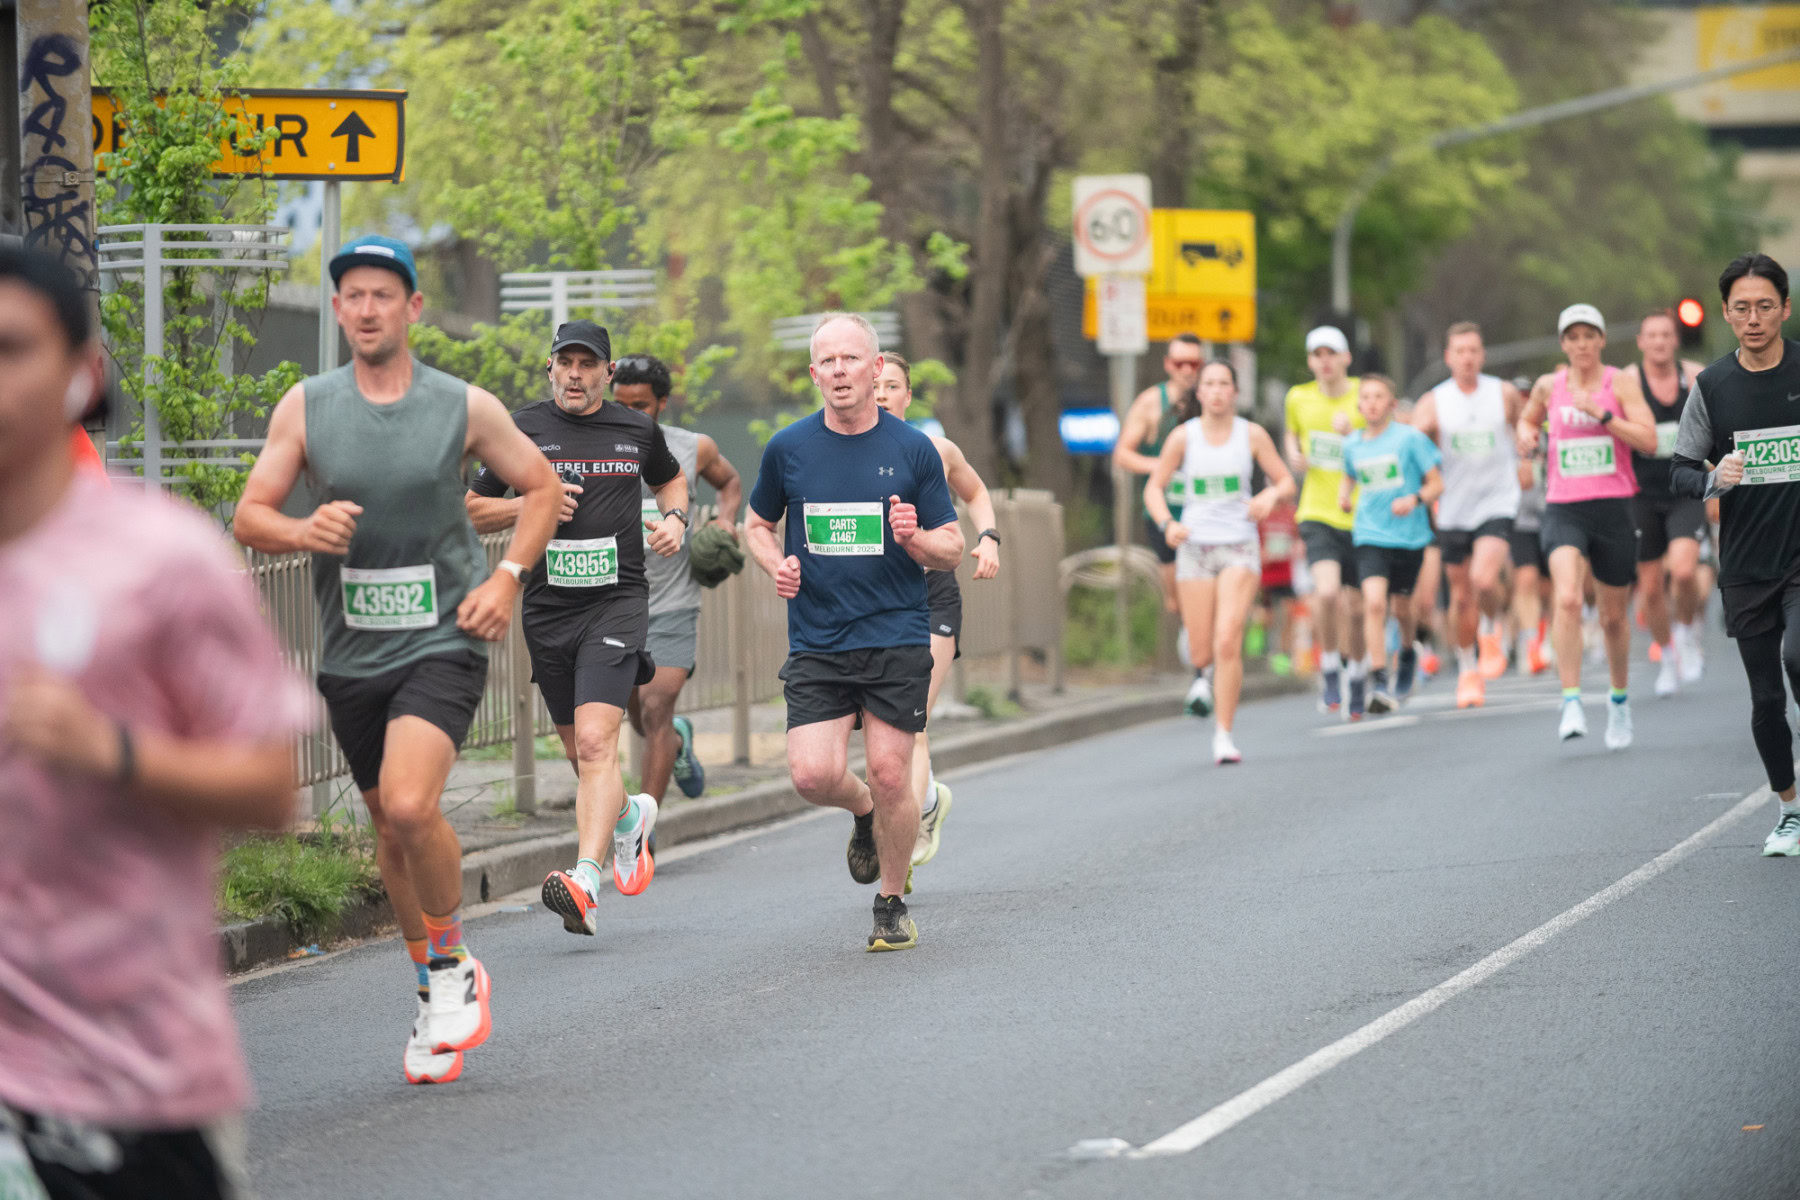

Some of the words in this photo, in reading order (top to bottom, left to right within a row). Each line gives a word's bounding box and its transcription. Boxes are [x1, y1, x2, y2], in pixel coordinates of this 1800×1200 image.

[92, 112, 308, 158] EUR
[1090, 207, 1137, 241] 60
[1746, 439, 1800, 466] 42303
[593, 462, 640, 474] ELTRON
[1745, 466, 1786, 475] MELBOURNE
[829, 518, 857, 531] CARTS
[830, 531, 857, 543] 41467
[814, 545, 854, 553] MELBOURNE
[857, 545, 876, 553] 2025
[553, 551, 610, 576] 43955
[553, 577, 592, 585] MELBOURNE
[352, 583, 425, 614] 43592
